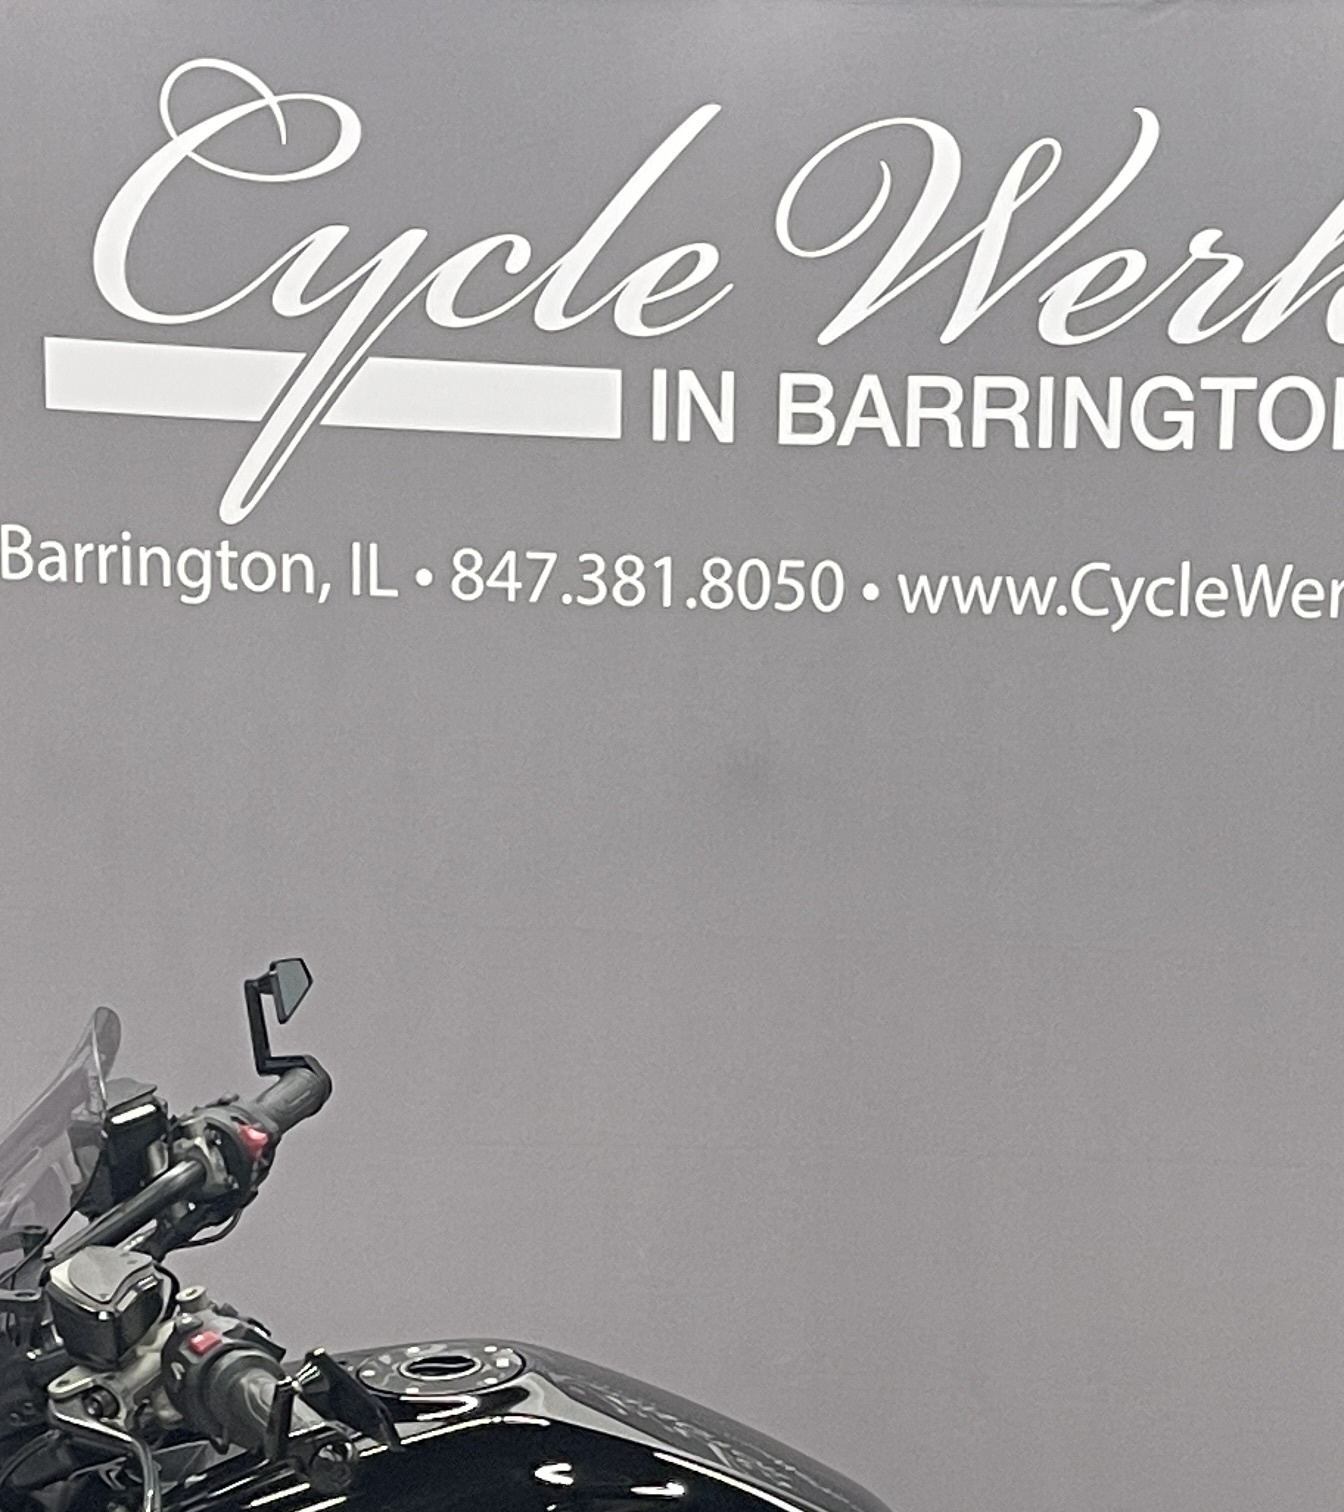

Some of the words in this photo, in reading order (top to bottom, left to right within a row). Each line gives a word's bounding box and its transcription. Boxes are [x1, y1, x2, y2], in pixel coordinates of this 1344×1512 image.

[94, 59, 733, 524] Cycle
[653, 369, 734, 442] IN
[1, 524, 331, 604] Barrington,
[353, 542, 399, 597] IL
[452, 548, 844, 612] 847.381.8050
